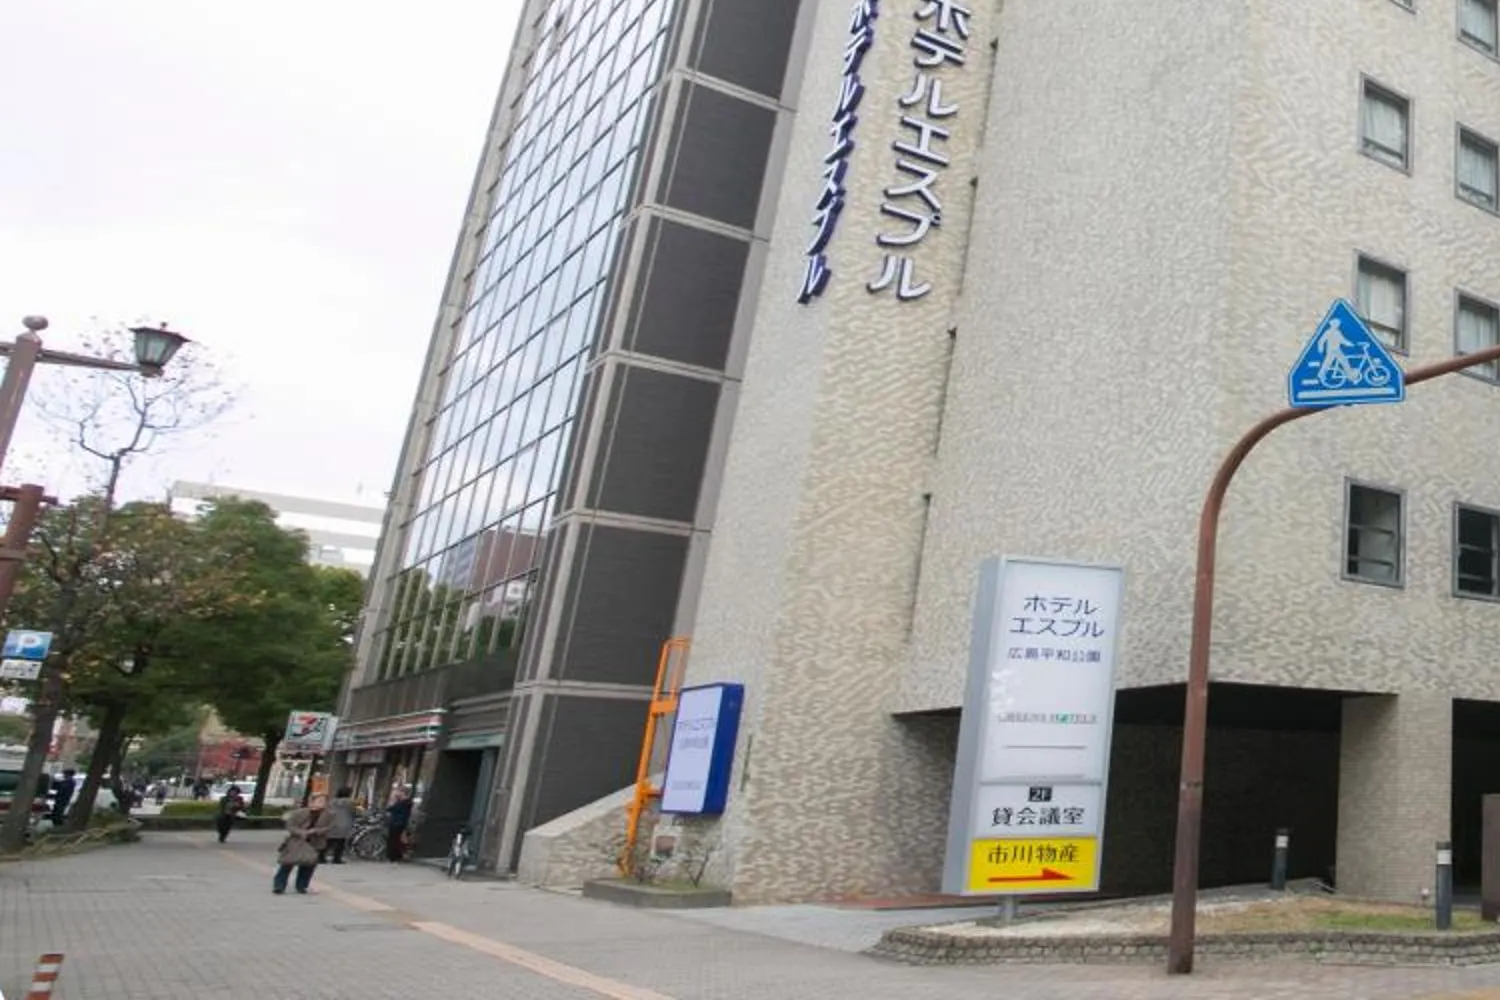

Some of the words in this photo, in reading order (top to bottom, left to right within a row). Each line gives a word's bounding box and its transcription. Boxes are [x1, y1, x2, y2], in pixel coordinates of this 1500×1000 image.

[1022, 594, 1099, 615] ホテル
[991, 807, 1085, 827] 貸会議室
[987, 844, 1080, 864] 市川物産
